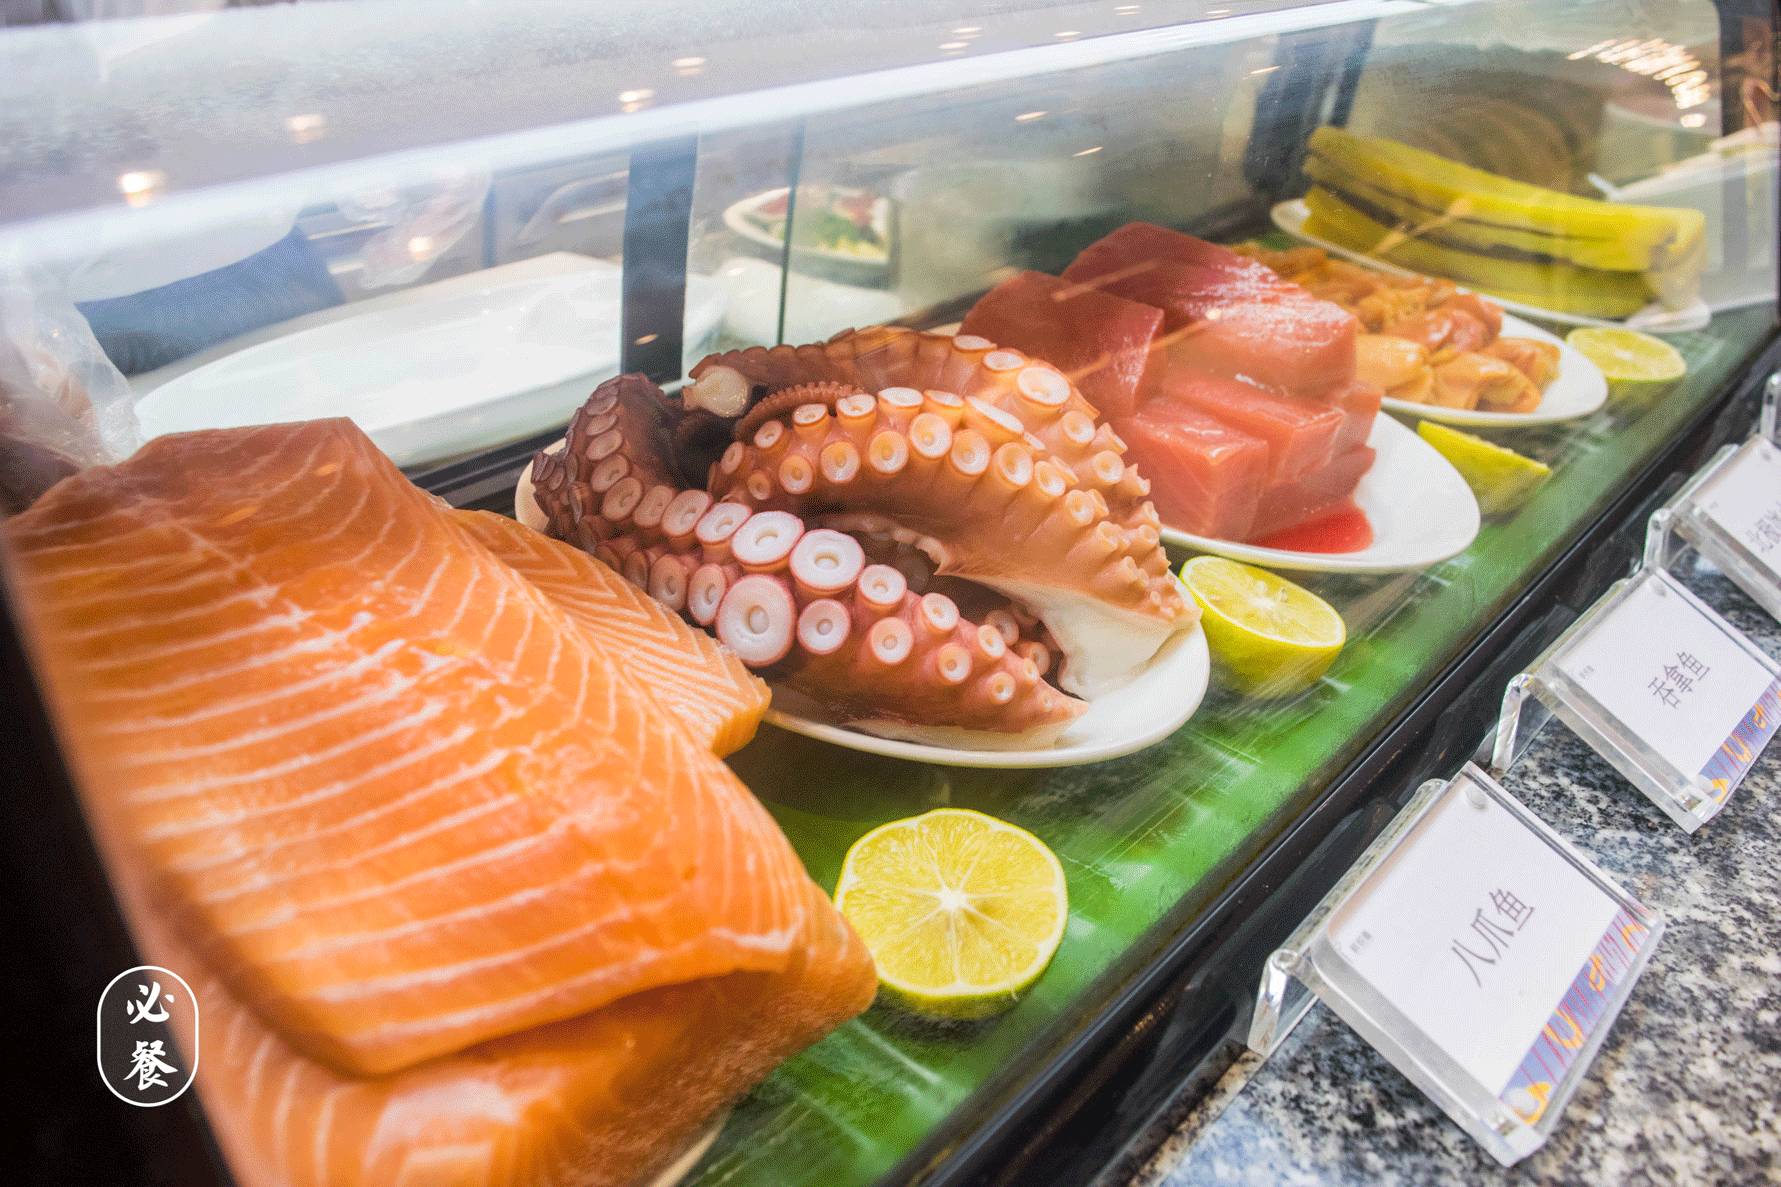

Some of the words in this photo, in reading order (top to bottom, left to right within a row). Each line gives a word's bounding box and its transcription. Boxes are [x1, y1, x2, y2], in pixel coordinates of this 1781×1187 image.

[1648, 651, 1710, 709] 吞拿鱼
[1451, 888, 1535, 988] 八爪鱼
